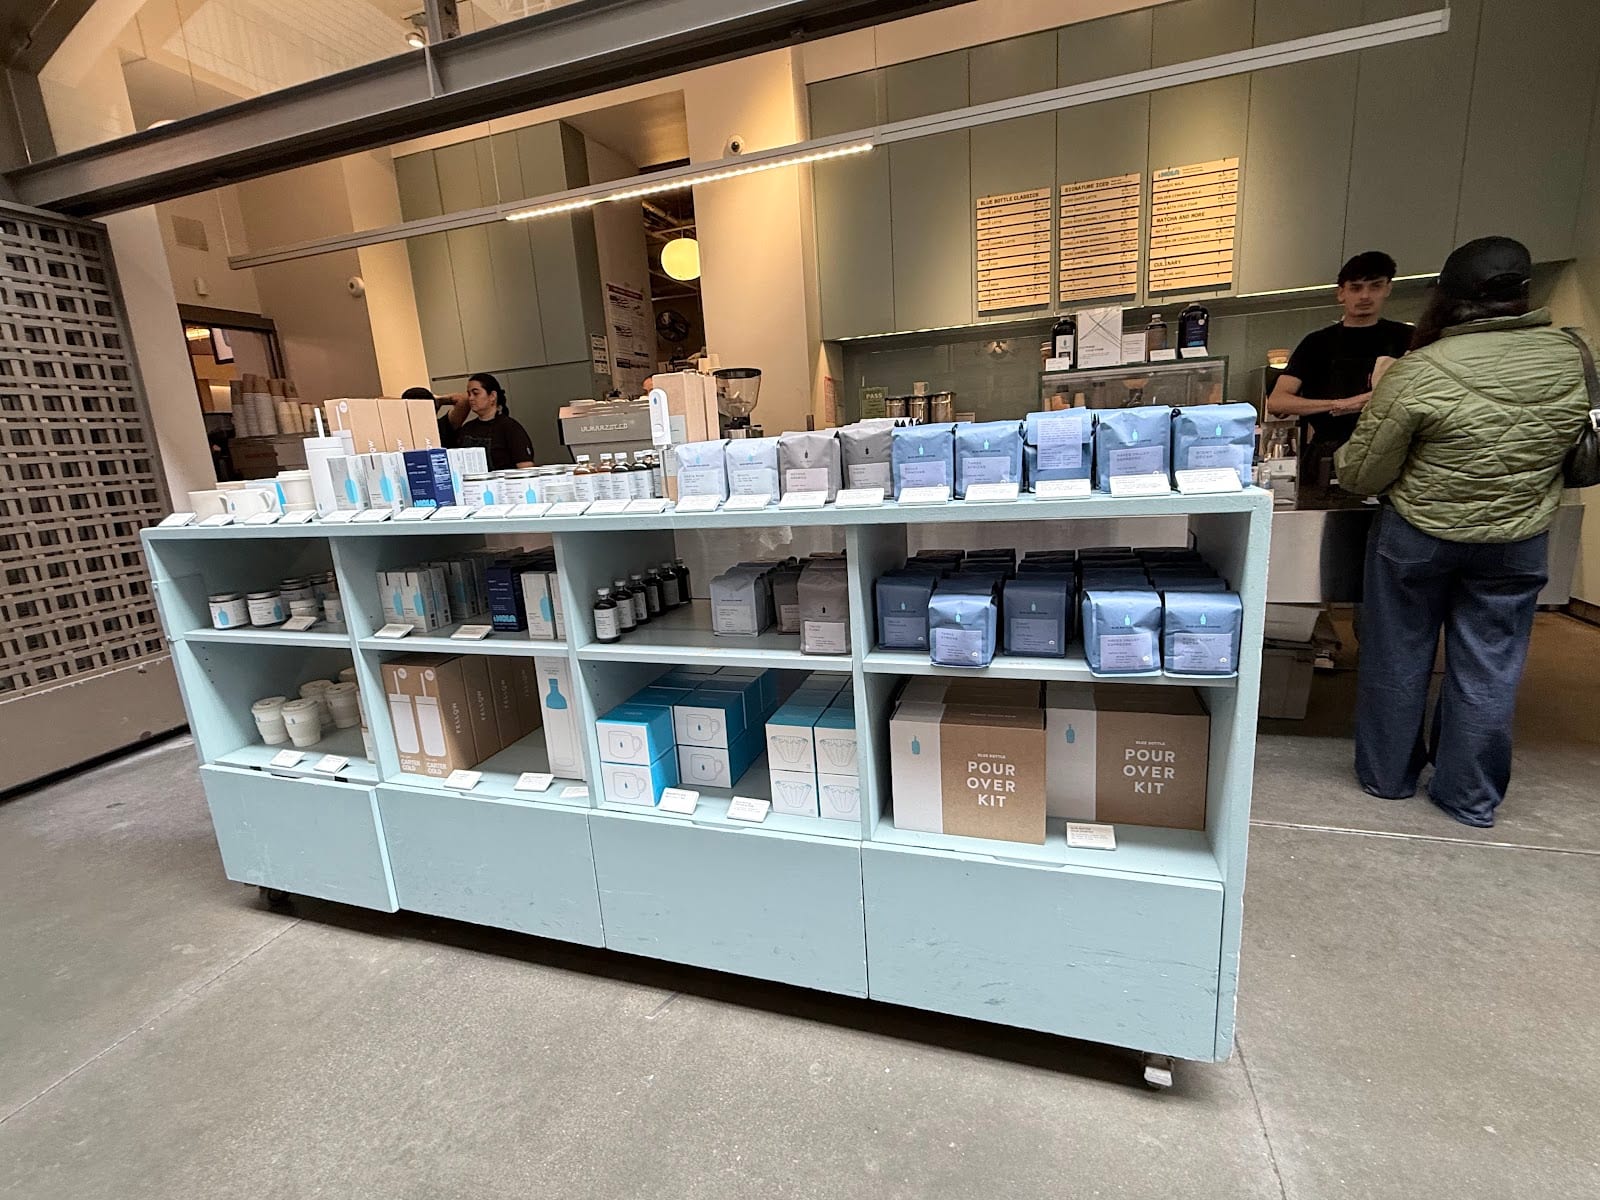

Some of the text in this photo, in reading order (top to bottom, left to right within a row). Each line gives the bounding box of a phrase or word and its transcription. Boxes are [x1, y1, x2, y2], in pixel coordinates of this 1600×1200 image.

[1065, 183, 1094, 193] SIGNATURE
[1014, 192, 1038, 200] CLASSICS
[1154, 260, 1181, 268] CULINARY
[453, 703, 461, 734] FELLOW
[1125, 748, 1175, 762] POUR
[968, 760, 1016, 776] POUR
[1123, 764, 1175, 779] OVER
[966, 777, 1016, 792] OVER
[1134, 781, 1165, 794] KIT
[978, 794, 1006, 808] KIT
